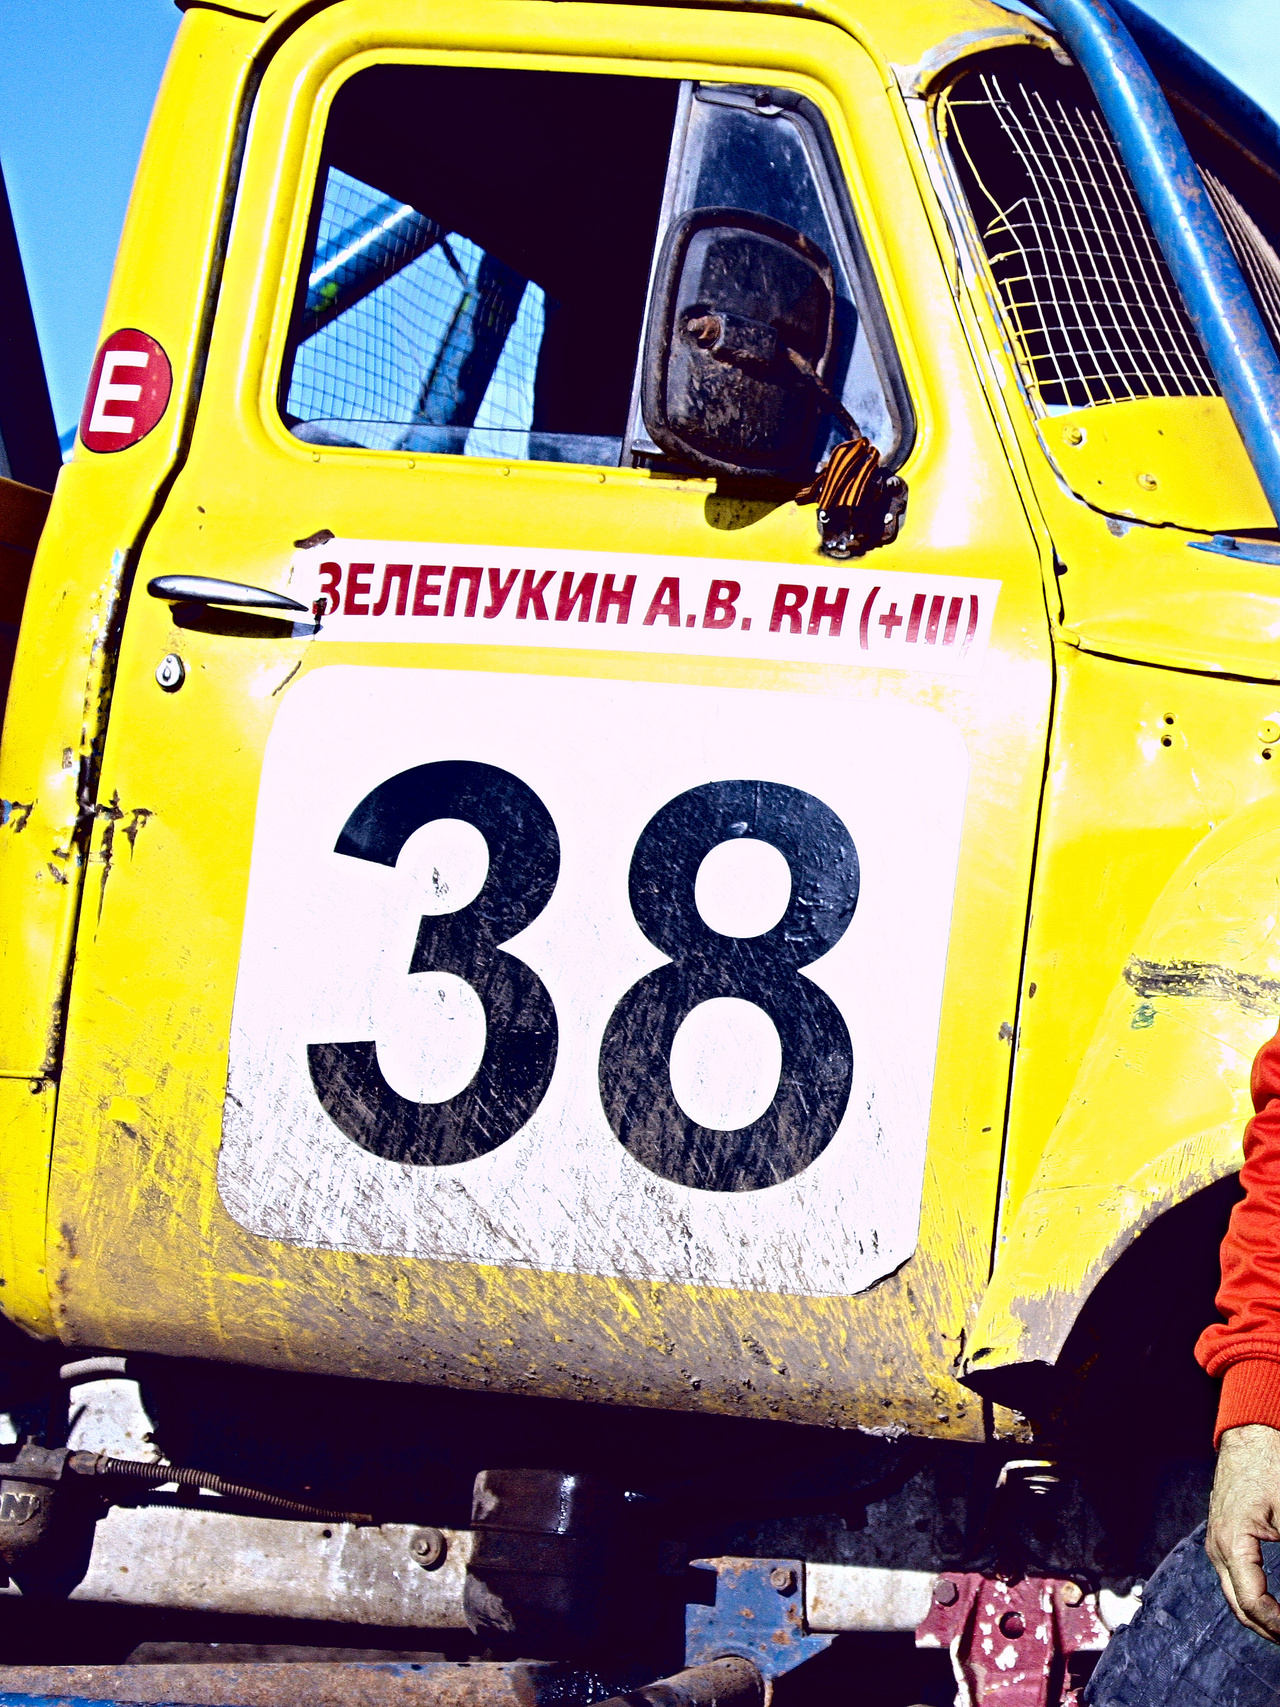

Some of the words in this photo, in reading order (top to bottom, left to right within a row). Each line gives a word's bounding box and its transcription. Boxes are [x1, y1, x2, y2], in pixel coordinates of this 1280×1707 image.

[88, 350, 149, 434] E
[312, 561, 637, 625] ЗЕЛЕПУКИН
[642, 576, 753, 631] А.В.
[306, 759, 861, 1193] 38
